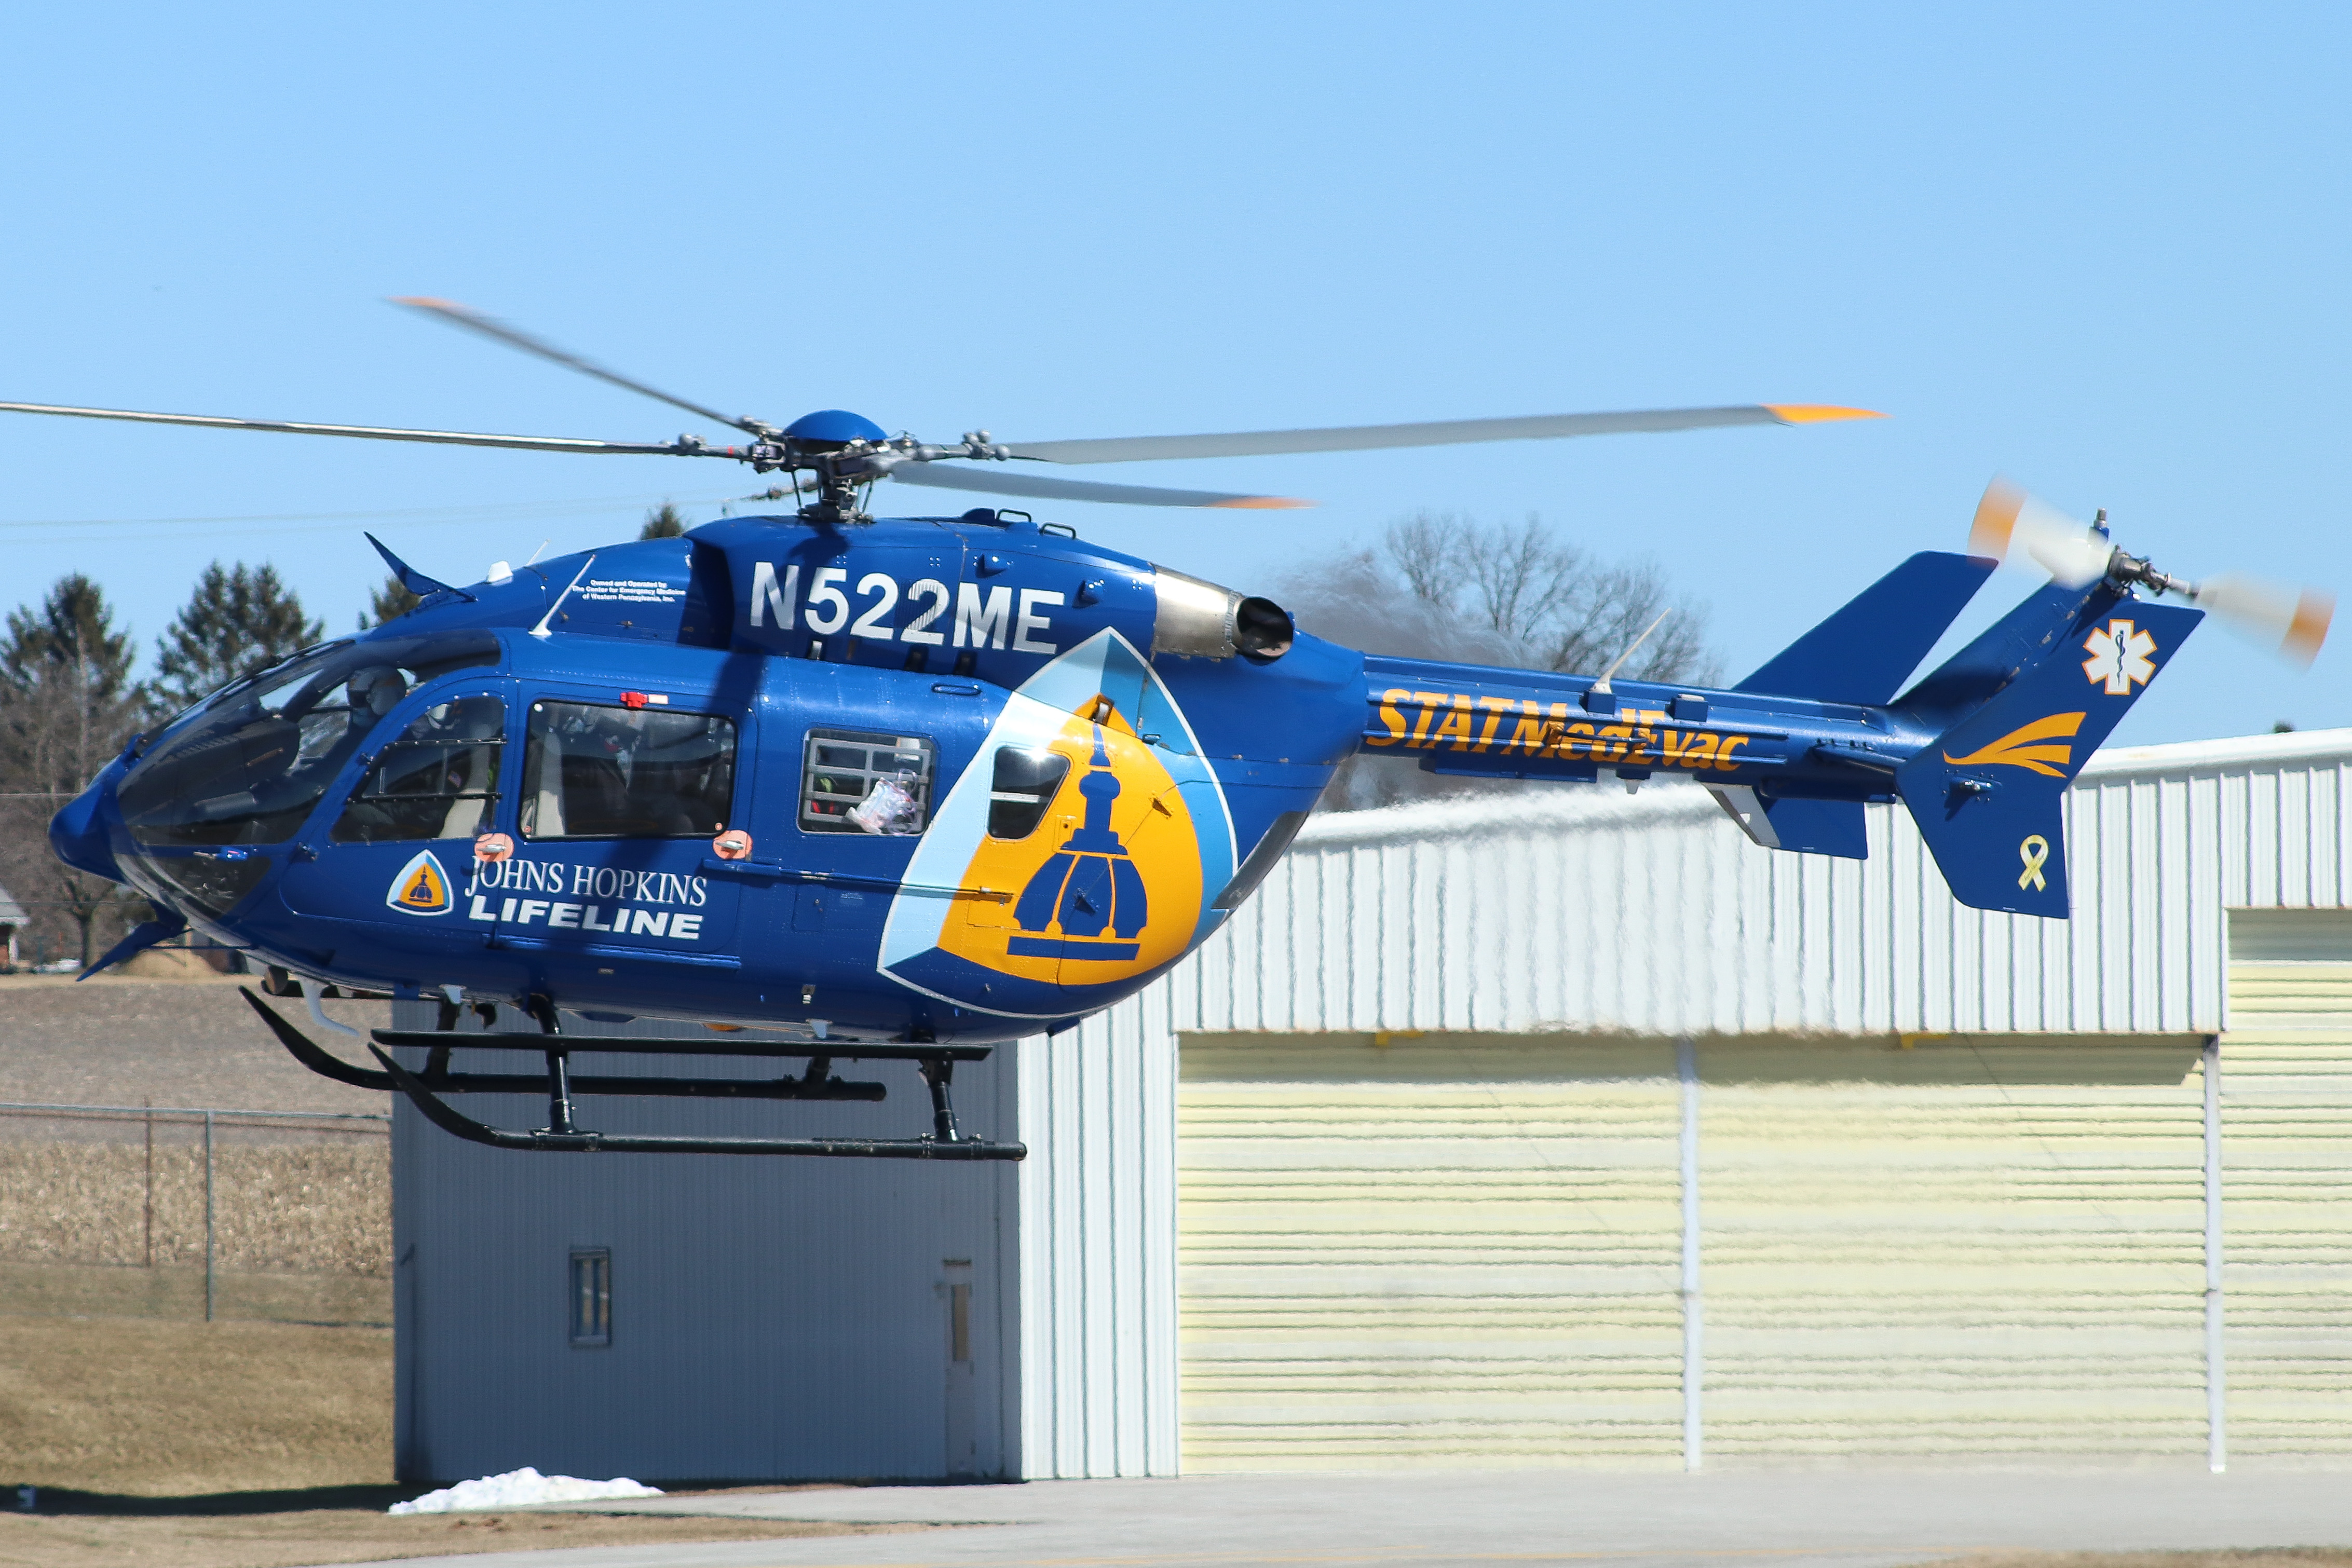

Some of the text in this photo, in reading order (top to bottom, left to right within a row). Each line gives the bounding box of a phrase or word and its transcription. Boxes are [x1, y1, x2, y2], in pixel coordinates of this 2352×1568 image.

[619, 587, 655, 595] Emergency
[750, 561, 1065, 655] N522ME
[465, 854, 707, 907] JOHNS HOPKINS
[469, 895, 703, 940] LIFELINE
